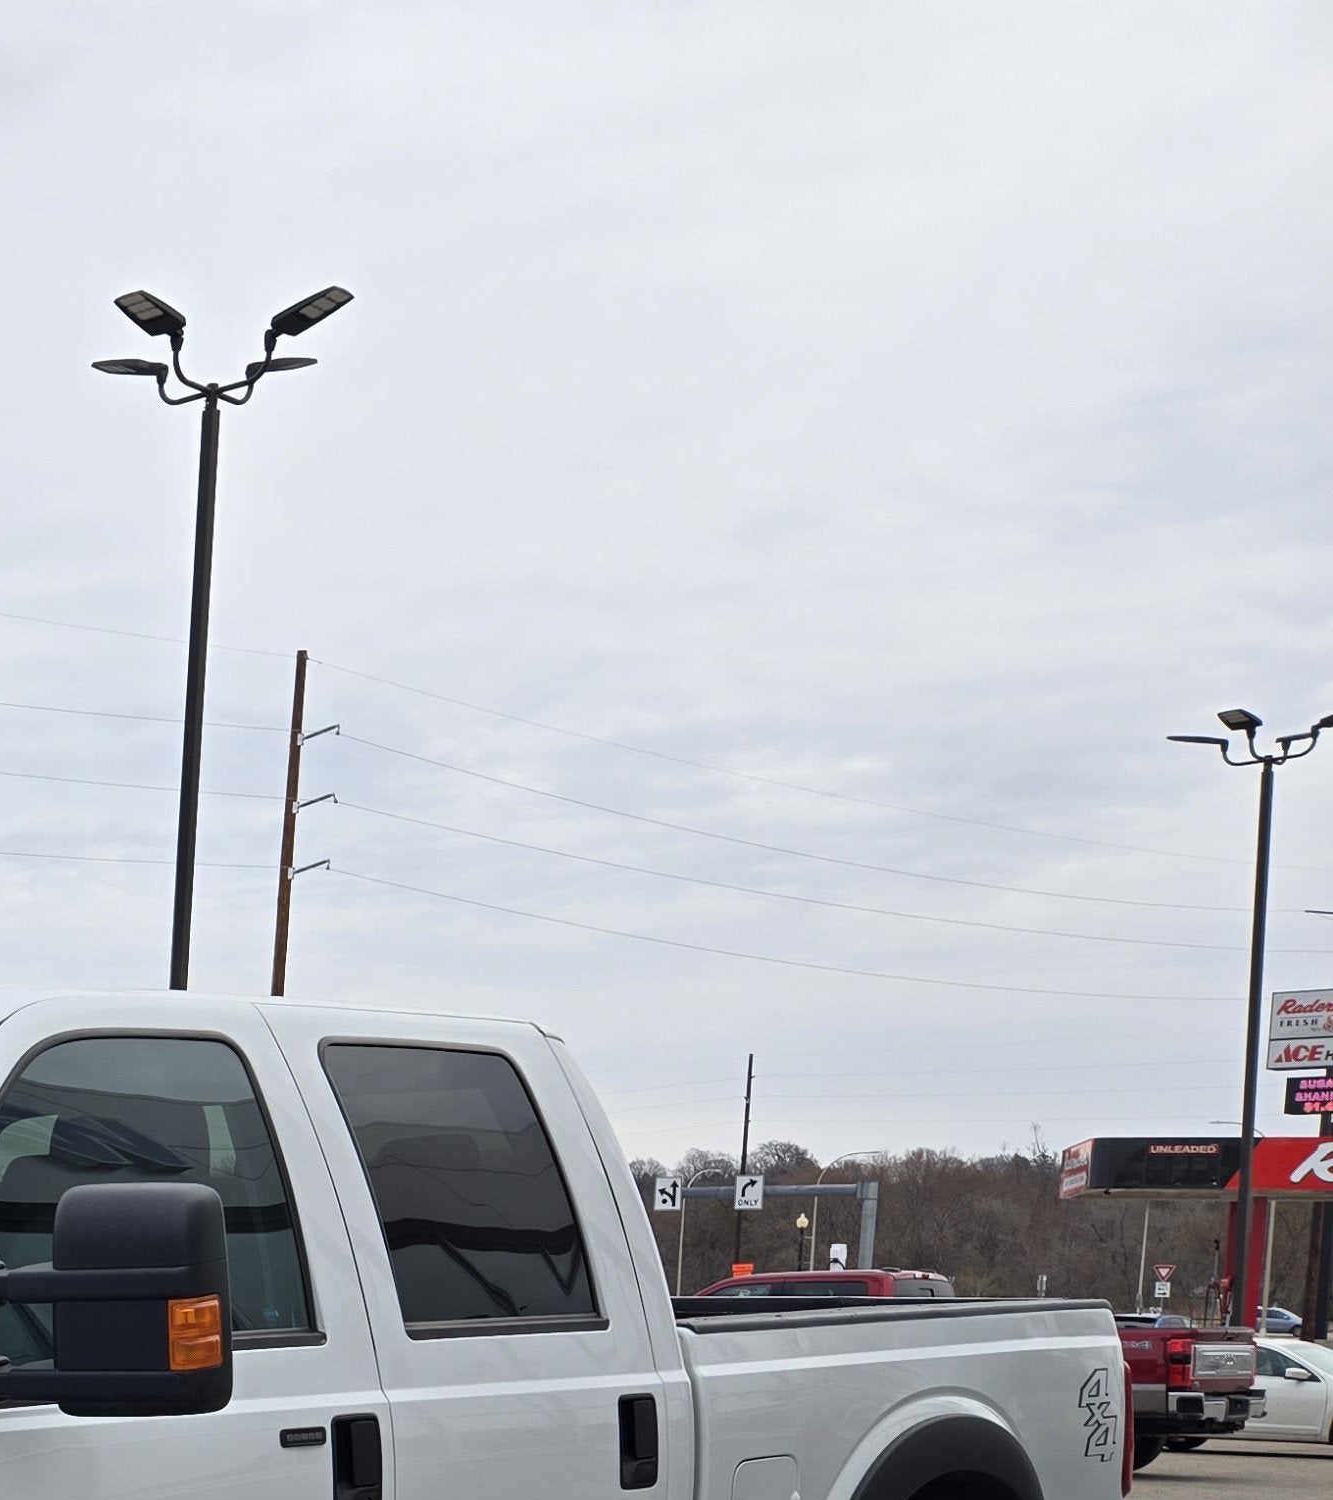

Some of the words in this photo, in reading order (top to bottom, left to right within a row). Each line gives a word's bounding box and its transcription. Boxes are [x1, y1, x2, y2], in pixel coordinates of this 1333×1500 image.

[1280, 1018, 1318, 1027] FRESH
[1274, 1043, 1324, 1063] ACE
[1150, 1144, 1217, 1154] UNLEADED
